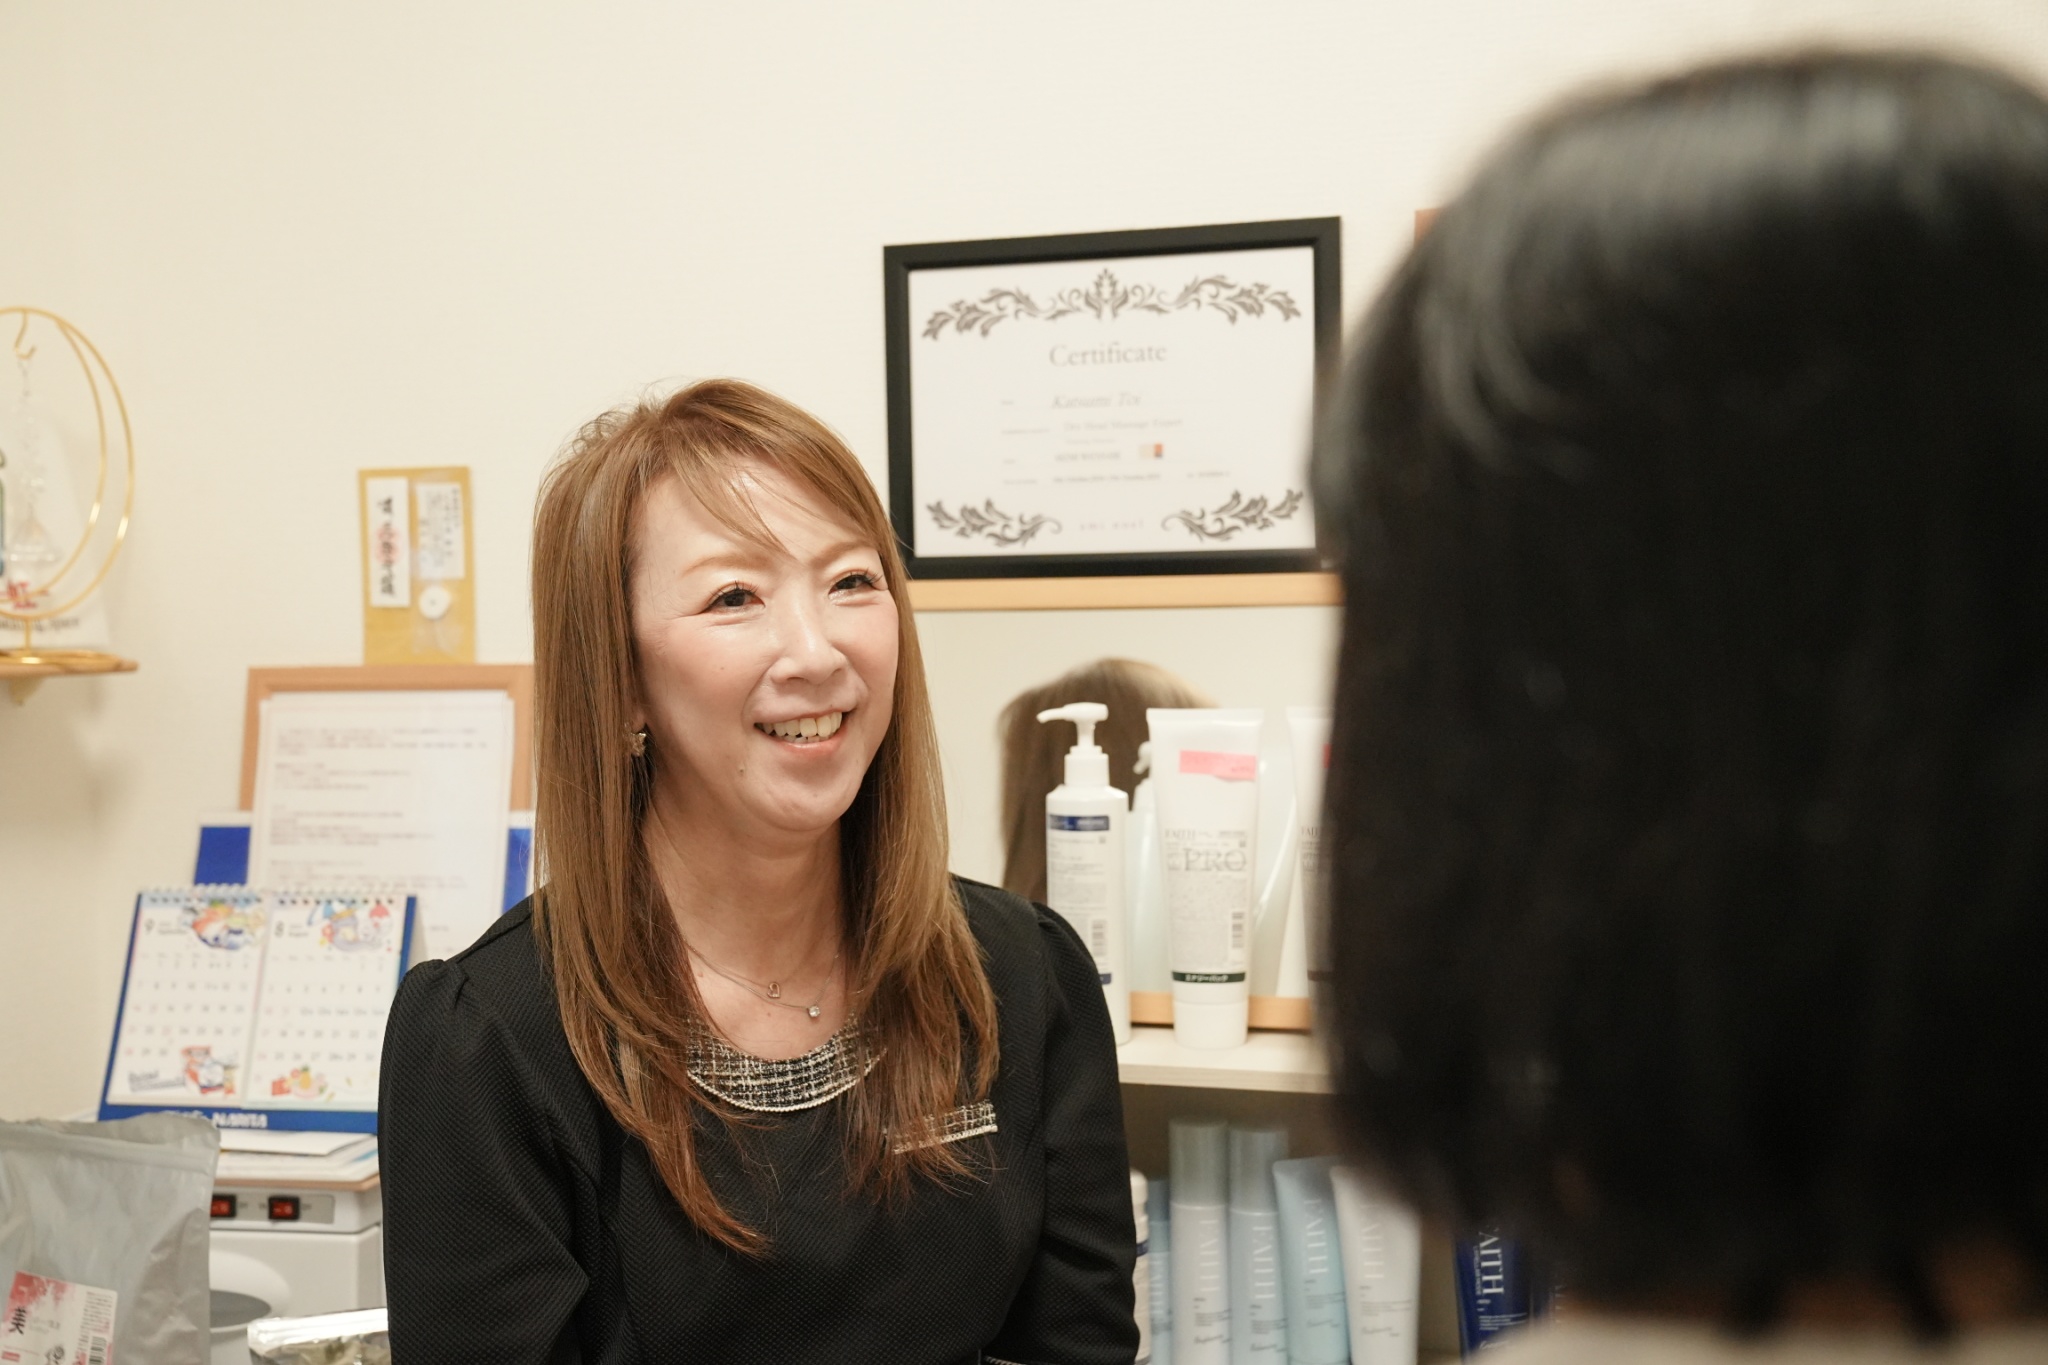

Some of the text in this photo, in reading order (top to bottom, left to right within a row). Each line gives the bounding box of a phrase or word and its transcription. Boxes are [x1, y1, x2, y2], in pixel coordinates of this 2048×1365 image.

[1049, 340, 1168, 367] Certificate
[1184, 848, 1247, 872] PRO
[1478, 1226, 1504, 1295] AITH
